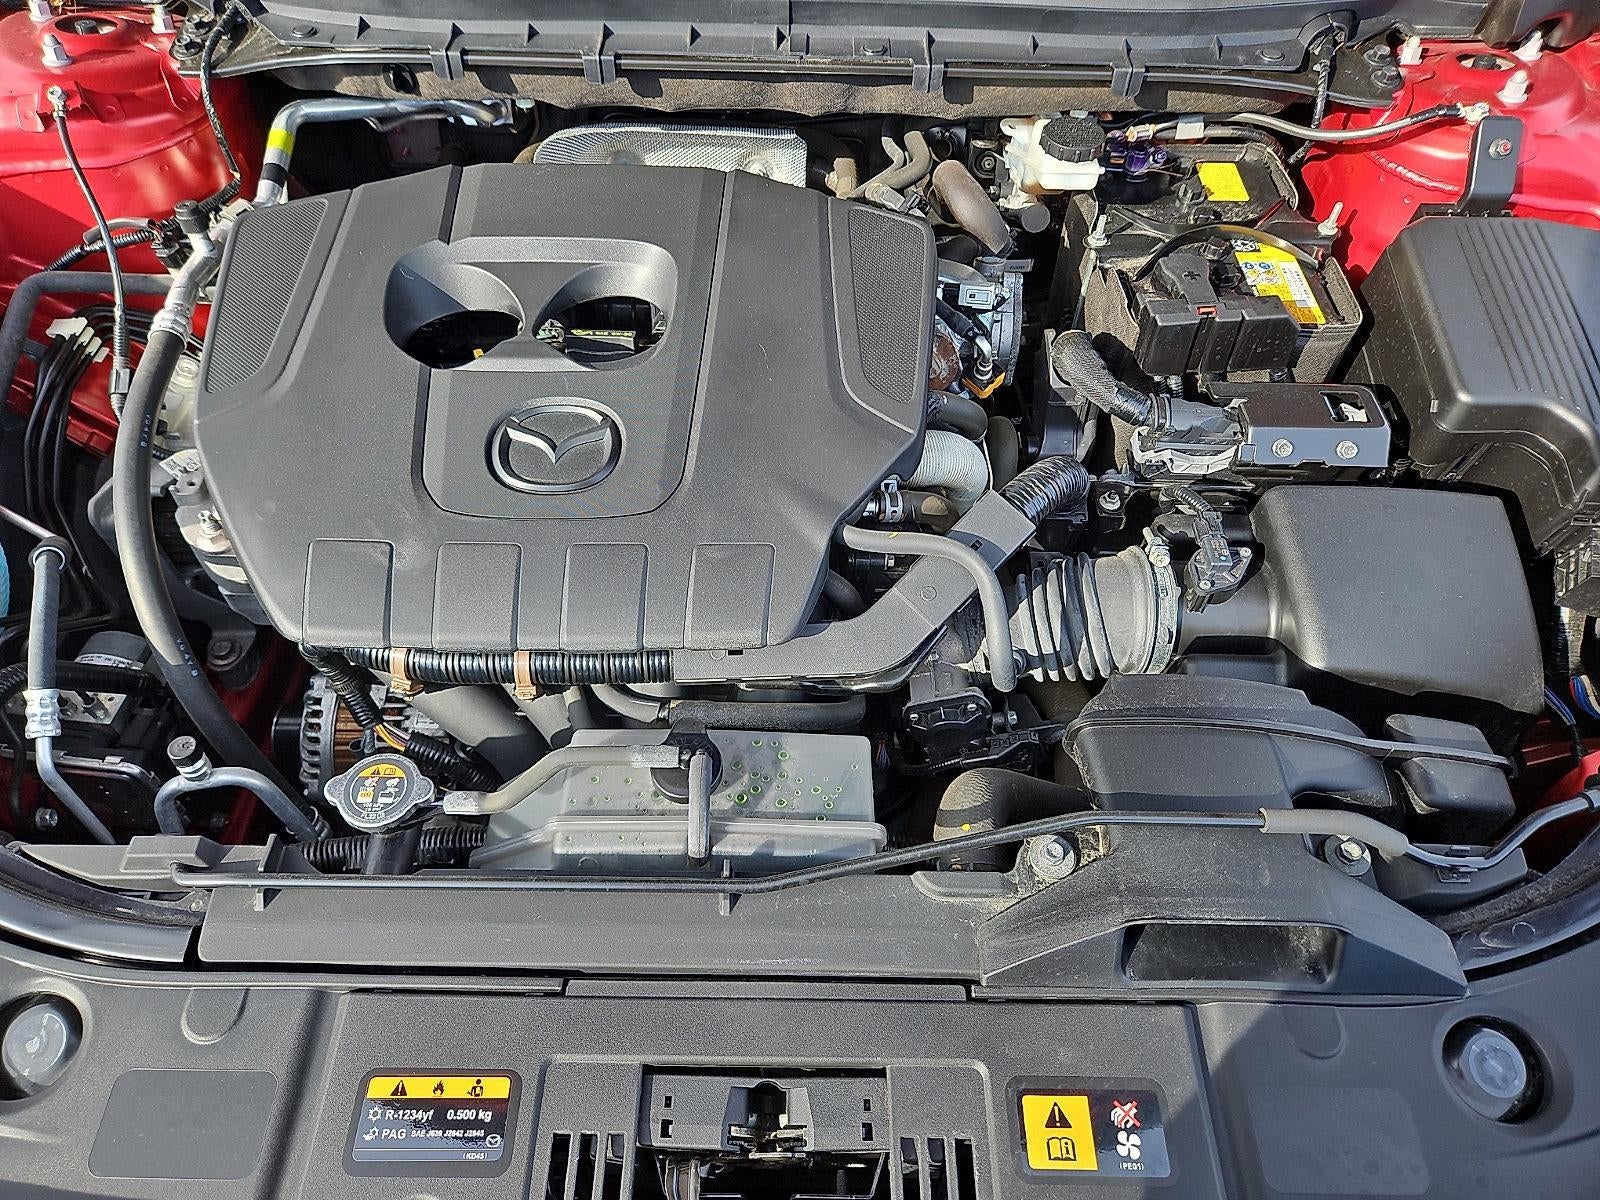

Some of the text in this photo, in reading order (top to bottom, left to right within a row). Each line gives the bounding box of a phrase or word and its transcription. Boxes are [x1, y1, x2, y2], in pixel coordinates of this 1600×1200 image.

[385, 1109, 492, 1122] R-1234yf 0.500 kg
[381, 1128, 407, 1140] PAG
[410, 1129, 426, 1138] SAE
[462, 1152, 488, 1160] (KD45)
[1119, 1162, 1144, 1170] (PE01)
